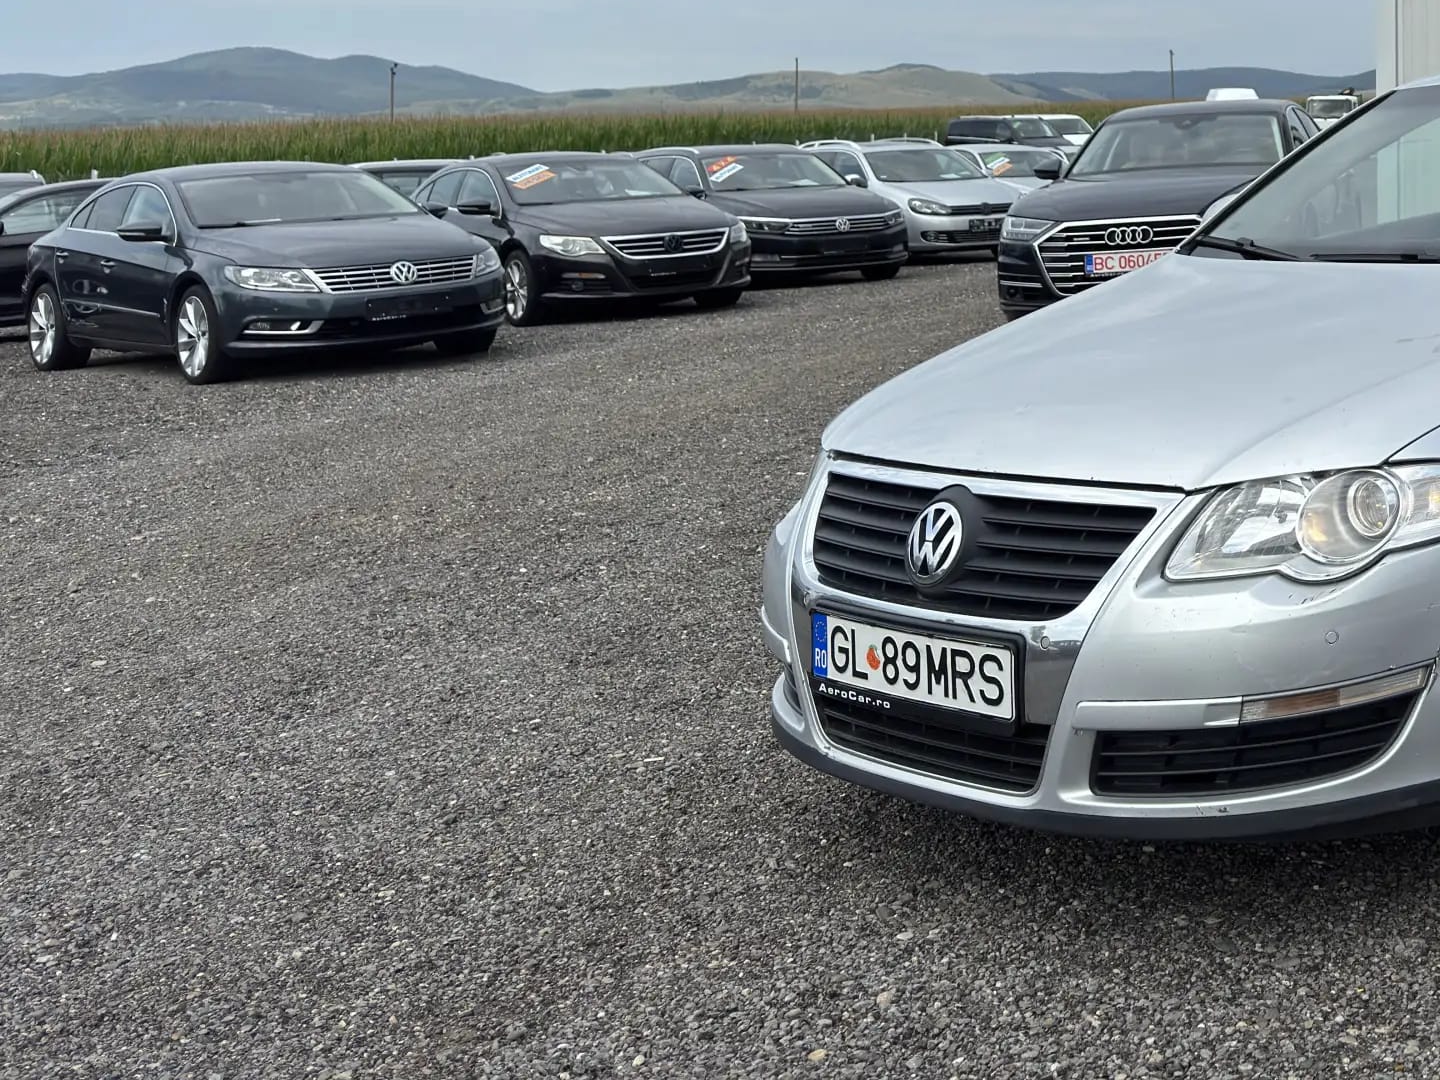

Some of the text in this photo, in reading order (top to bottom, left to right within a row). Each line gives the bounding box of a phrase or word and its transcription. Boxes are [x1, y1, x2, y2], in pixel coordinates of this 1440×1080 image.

[1094, 252, 1168, 271] BC 0604
[815, 647, 827, 670] RO
[830, 625, 869, 681] GL
[818, 682, 891, 709] AeroCar.ro
